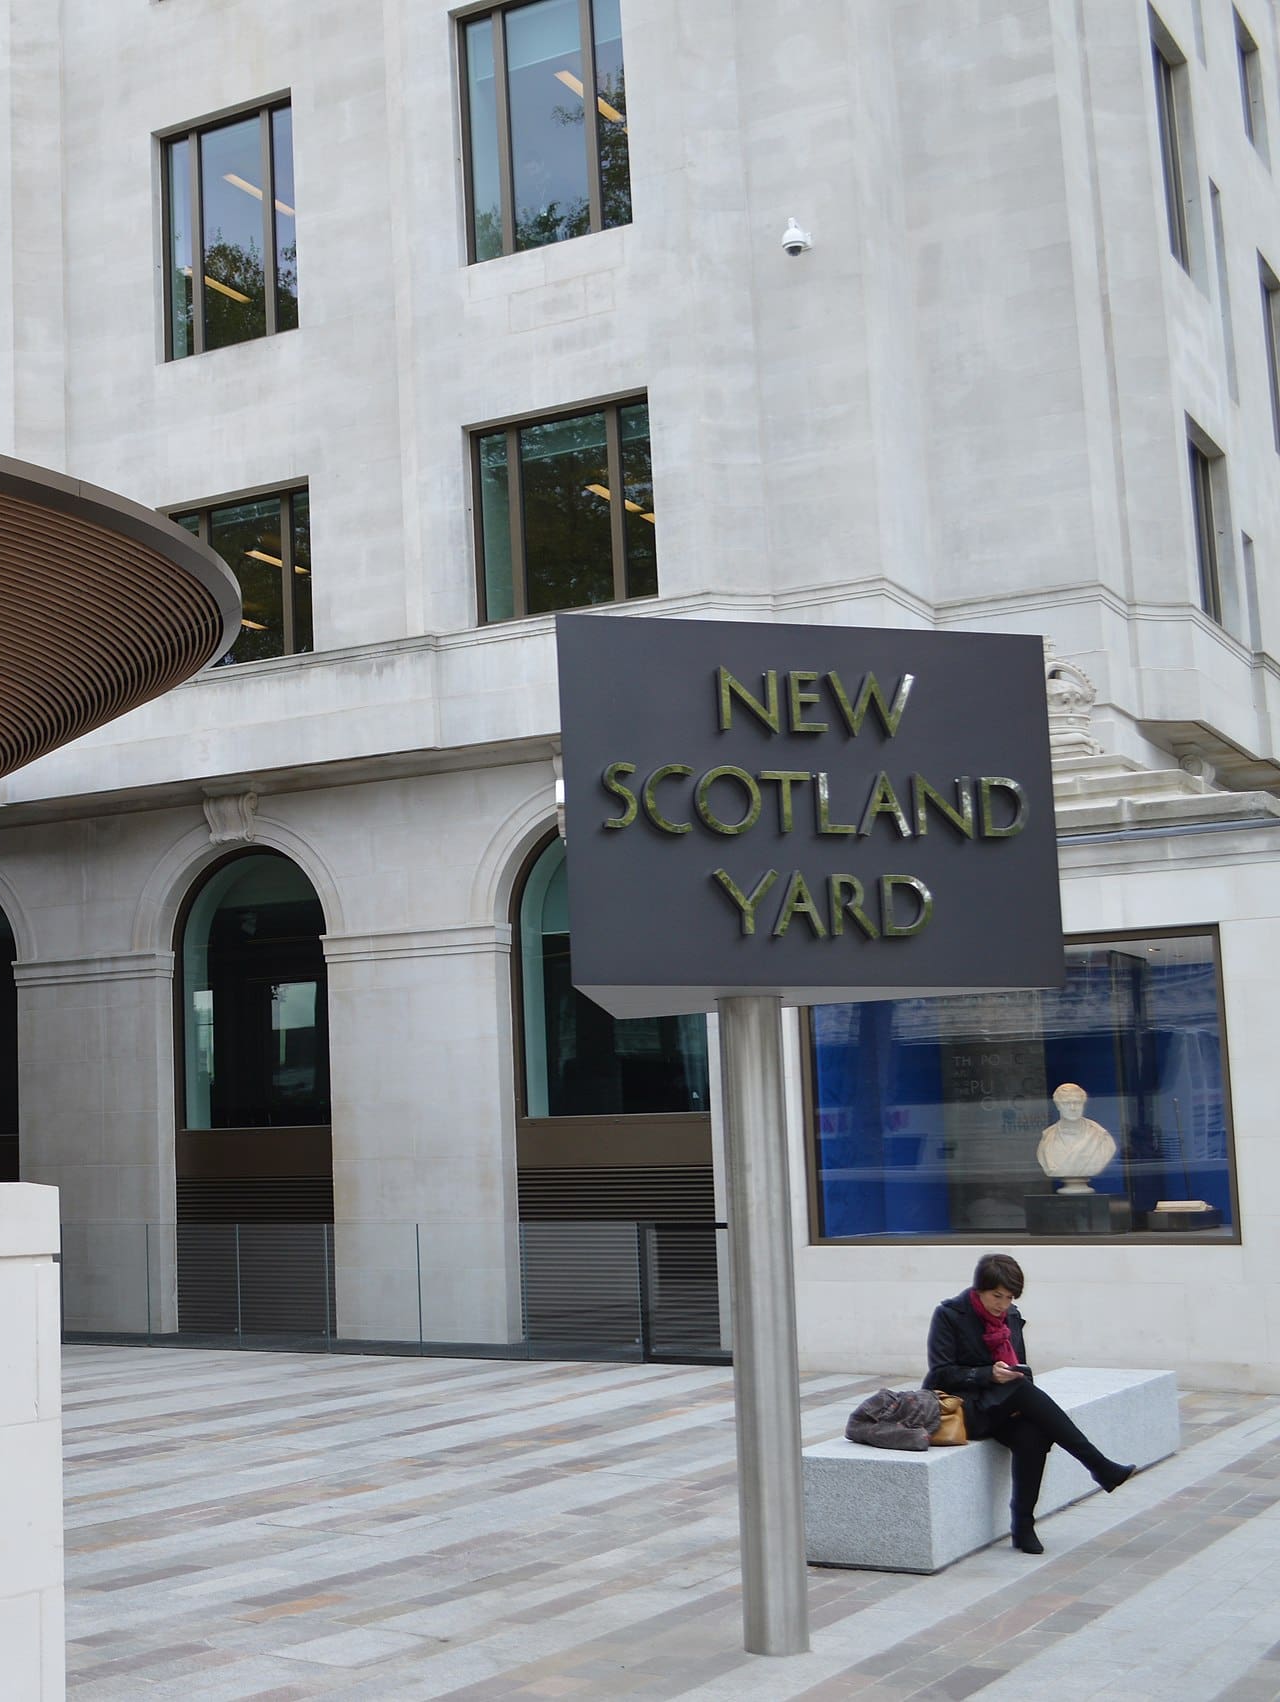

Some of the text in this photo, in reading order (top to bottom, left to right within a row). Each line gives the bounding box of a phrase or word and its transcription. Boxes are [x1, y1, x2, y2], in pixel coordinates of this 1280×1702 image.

[715, 665, 915, 738] NEW
[601, 762, 1029, 840] SCOTLAND
[711, 868, 934, 940] YARD
